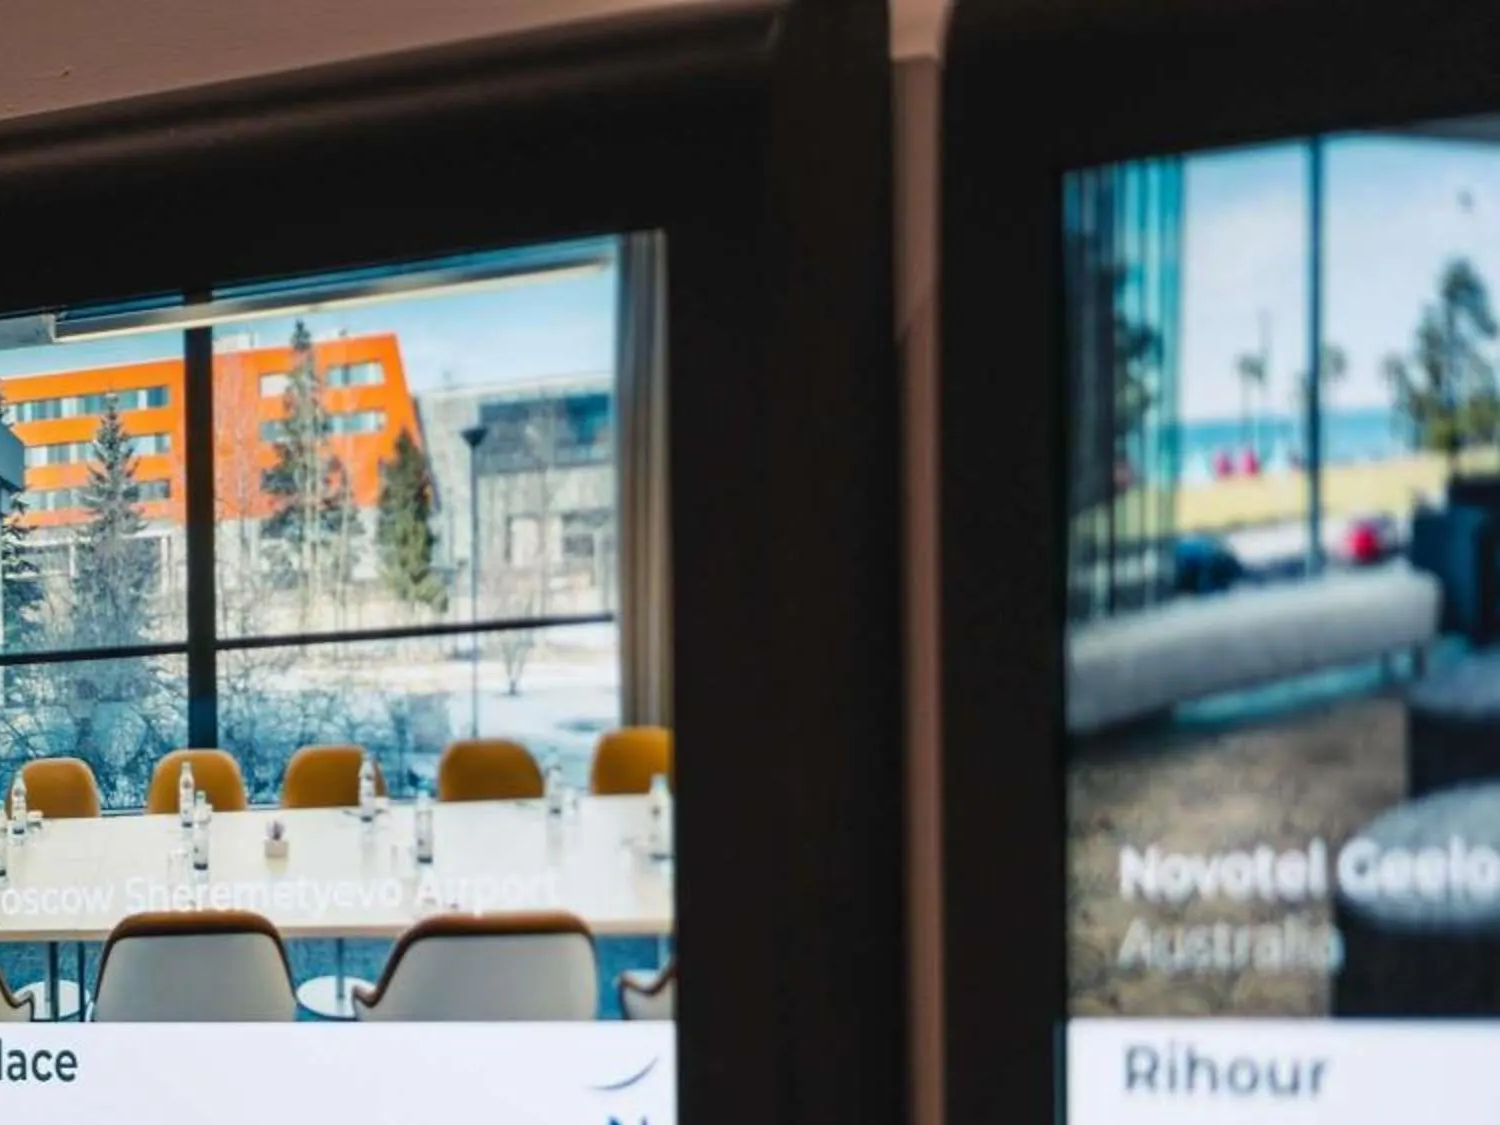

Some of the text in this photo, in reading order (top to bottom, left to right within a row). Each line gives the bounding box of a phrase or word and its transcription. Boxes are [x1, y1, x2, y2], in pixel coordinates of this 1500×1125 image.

[124, 875, 404, 913] Sheremetyevo
[415, 870, 561, 915] Airport
[1117, 837, 1329, 902] Novotel
[1118, 915, 1345, 974] Australia
[1122, 1040, 1330, 1098] Rihour
